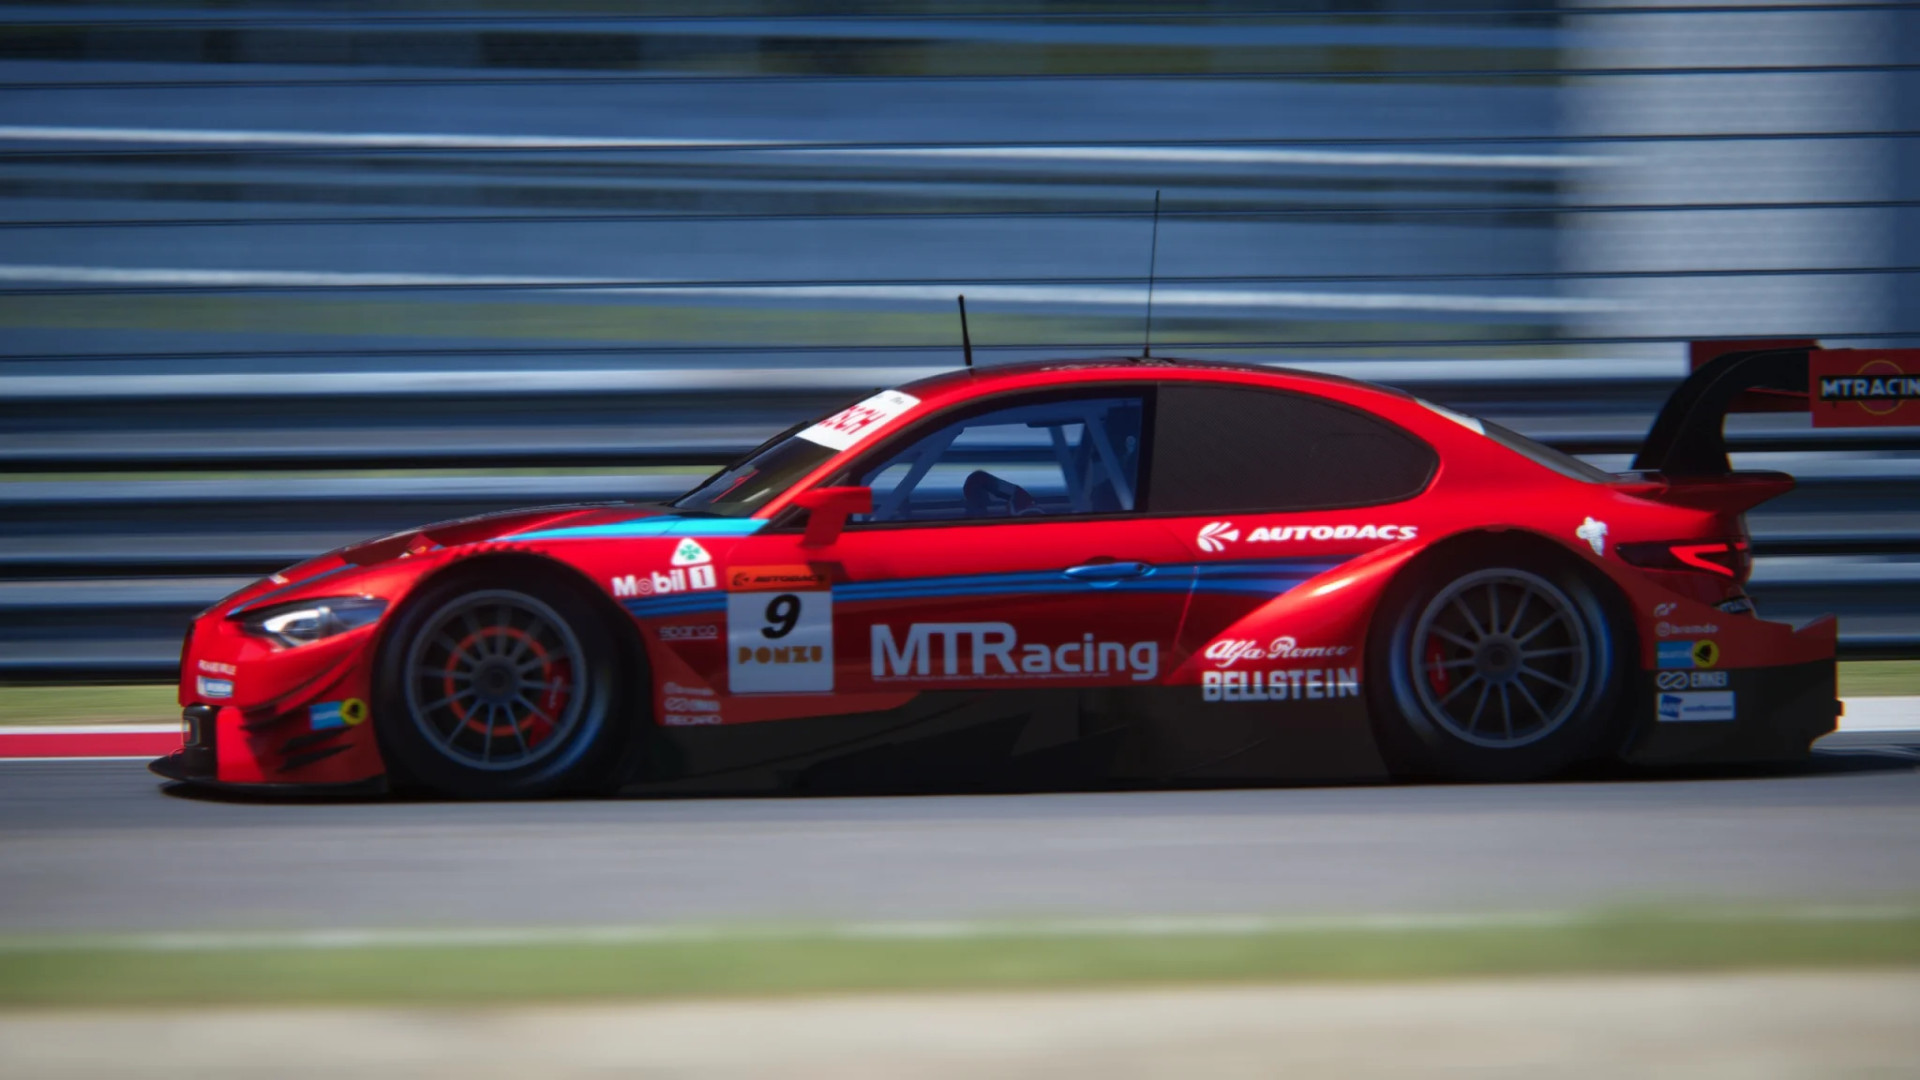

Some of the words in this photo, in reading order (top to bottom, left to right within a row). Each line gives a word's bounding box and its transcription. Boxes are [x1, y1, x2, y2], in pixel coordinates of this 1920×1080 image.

[1246, 524, 1418, 542] AUTODACS
[611, 569, 685, 597] Mobil
[760, 593, 802, 640] 9
[737, 645, 823, 666] PONZU
[869, 621, 1159, 681] MTRacing
[1204, 638, 1265, 669] Alfa
[1266, 635, 1354, 660] Romeo
[1202, 668, 1360, 702] BELLSTEIN
